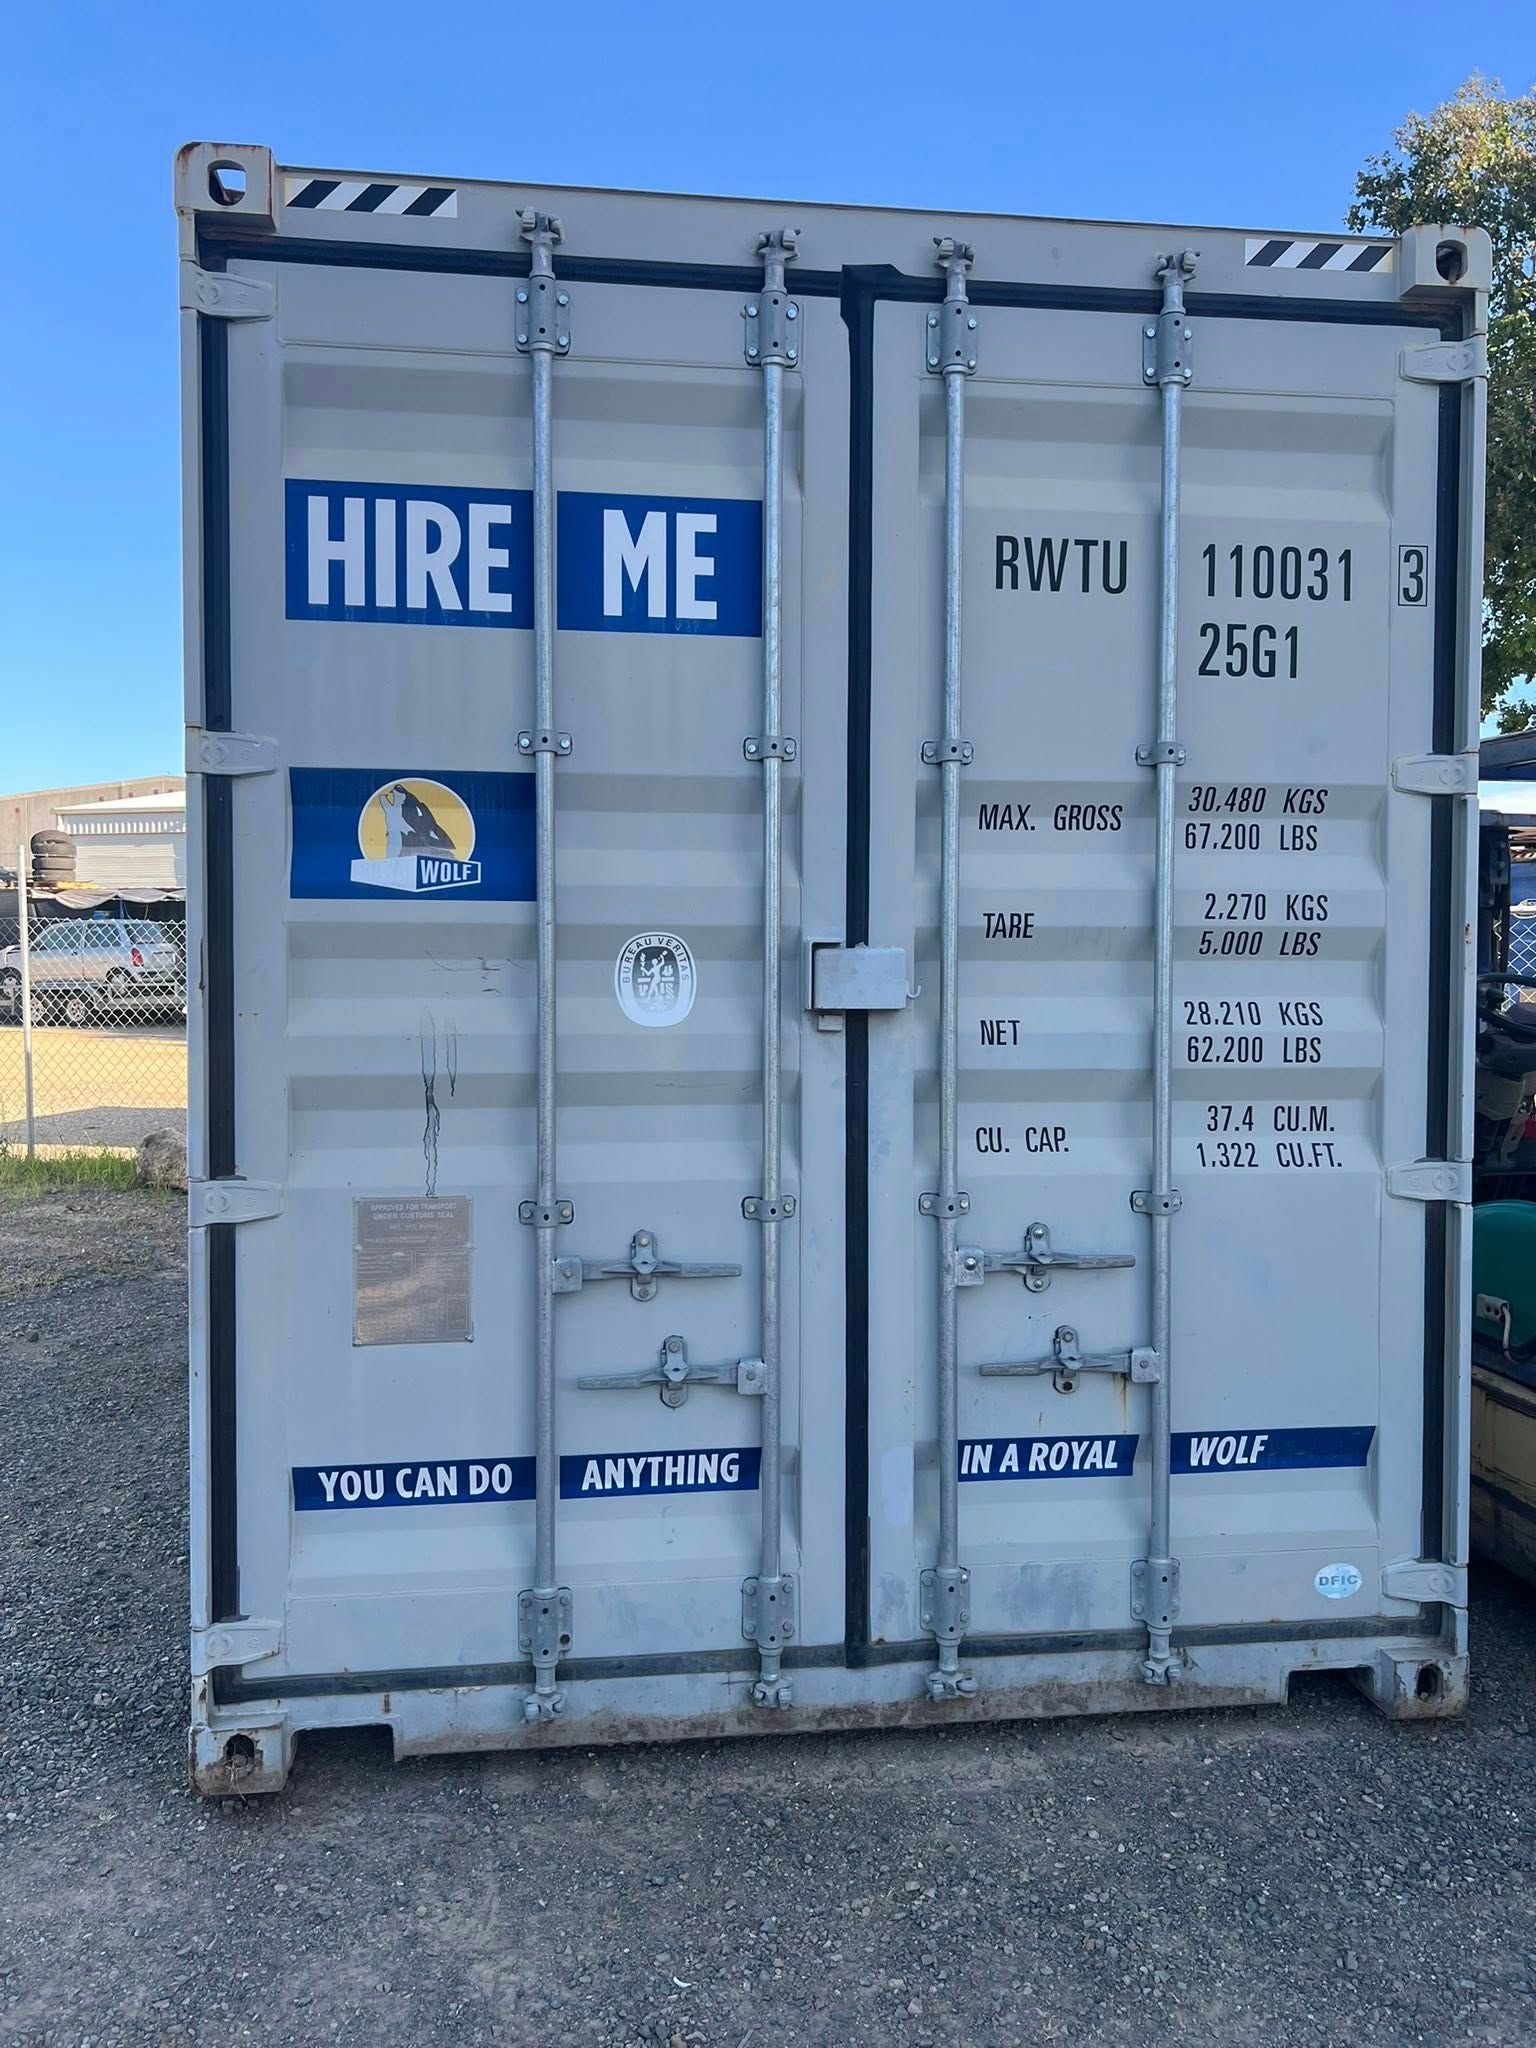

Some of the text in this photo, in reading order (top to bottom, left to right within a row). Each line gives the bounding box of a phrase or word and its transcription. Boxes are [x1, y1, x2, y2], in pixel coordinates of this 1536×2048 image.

[307, 495, 718, 620] HIRE ME
[996, 535, 1424, 602] RWTU 110031 3
[1199, 622, 1297, 678] 25G1
[1283, 788, 1328, 814] KGS
[979, 803, 1123, 831] MAX. GROSS
[1280, 824, 1318, 851] LBS
[420, 859, 472, 884] WOLF
[1286, 894, 1328, 921] KGS
[983, 913, 1034, 938] TARE
[1280, 931, 1321, 956] LBS
[623, 938, 689, 983] BUREAU VERITAS
[1278, 1001, 1323, 1026] KGS
[980, 1019, 1020, 1045] NET
[1283, 1037, 1321, 1063] LBS
[1207, 1105, 1335, 1132] 37.4 CU.M.
[976, 1126, 1069, 1153] CU. CAP.
[1276, 1142, 1343, 1168] CU.FT.
[370, 1203, 404, 1212] APPROVED
[406, 1203, 419, 1211] FOR
[318, 1434, 1269, 1503] YOU CAN DO ANYTHING IN A ROYAL WOLF
[1318, 1574, 1359, 1586] DFIC
